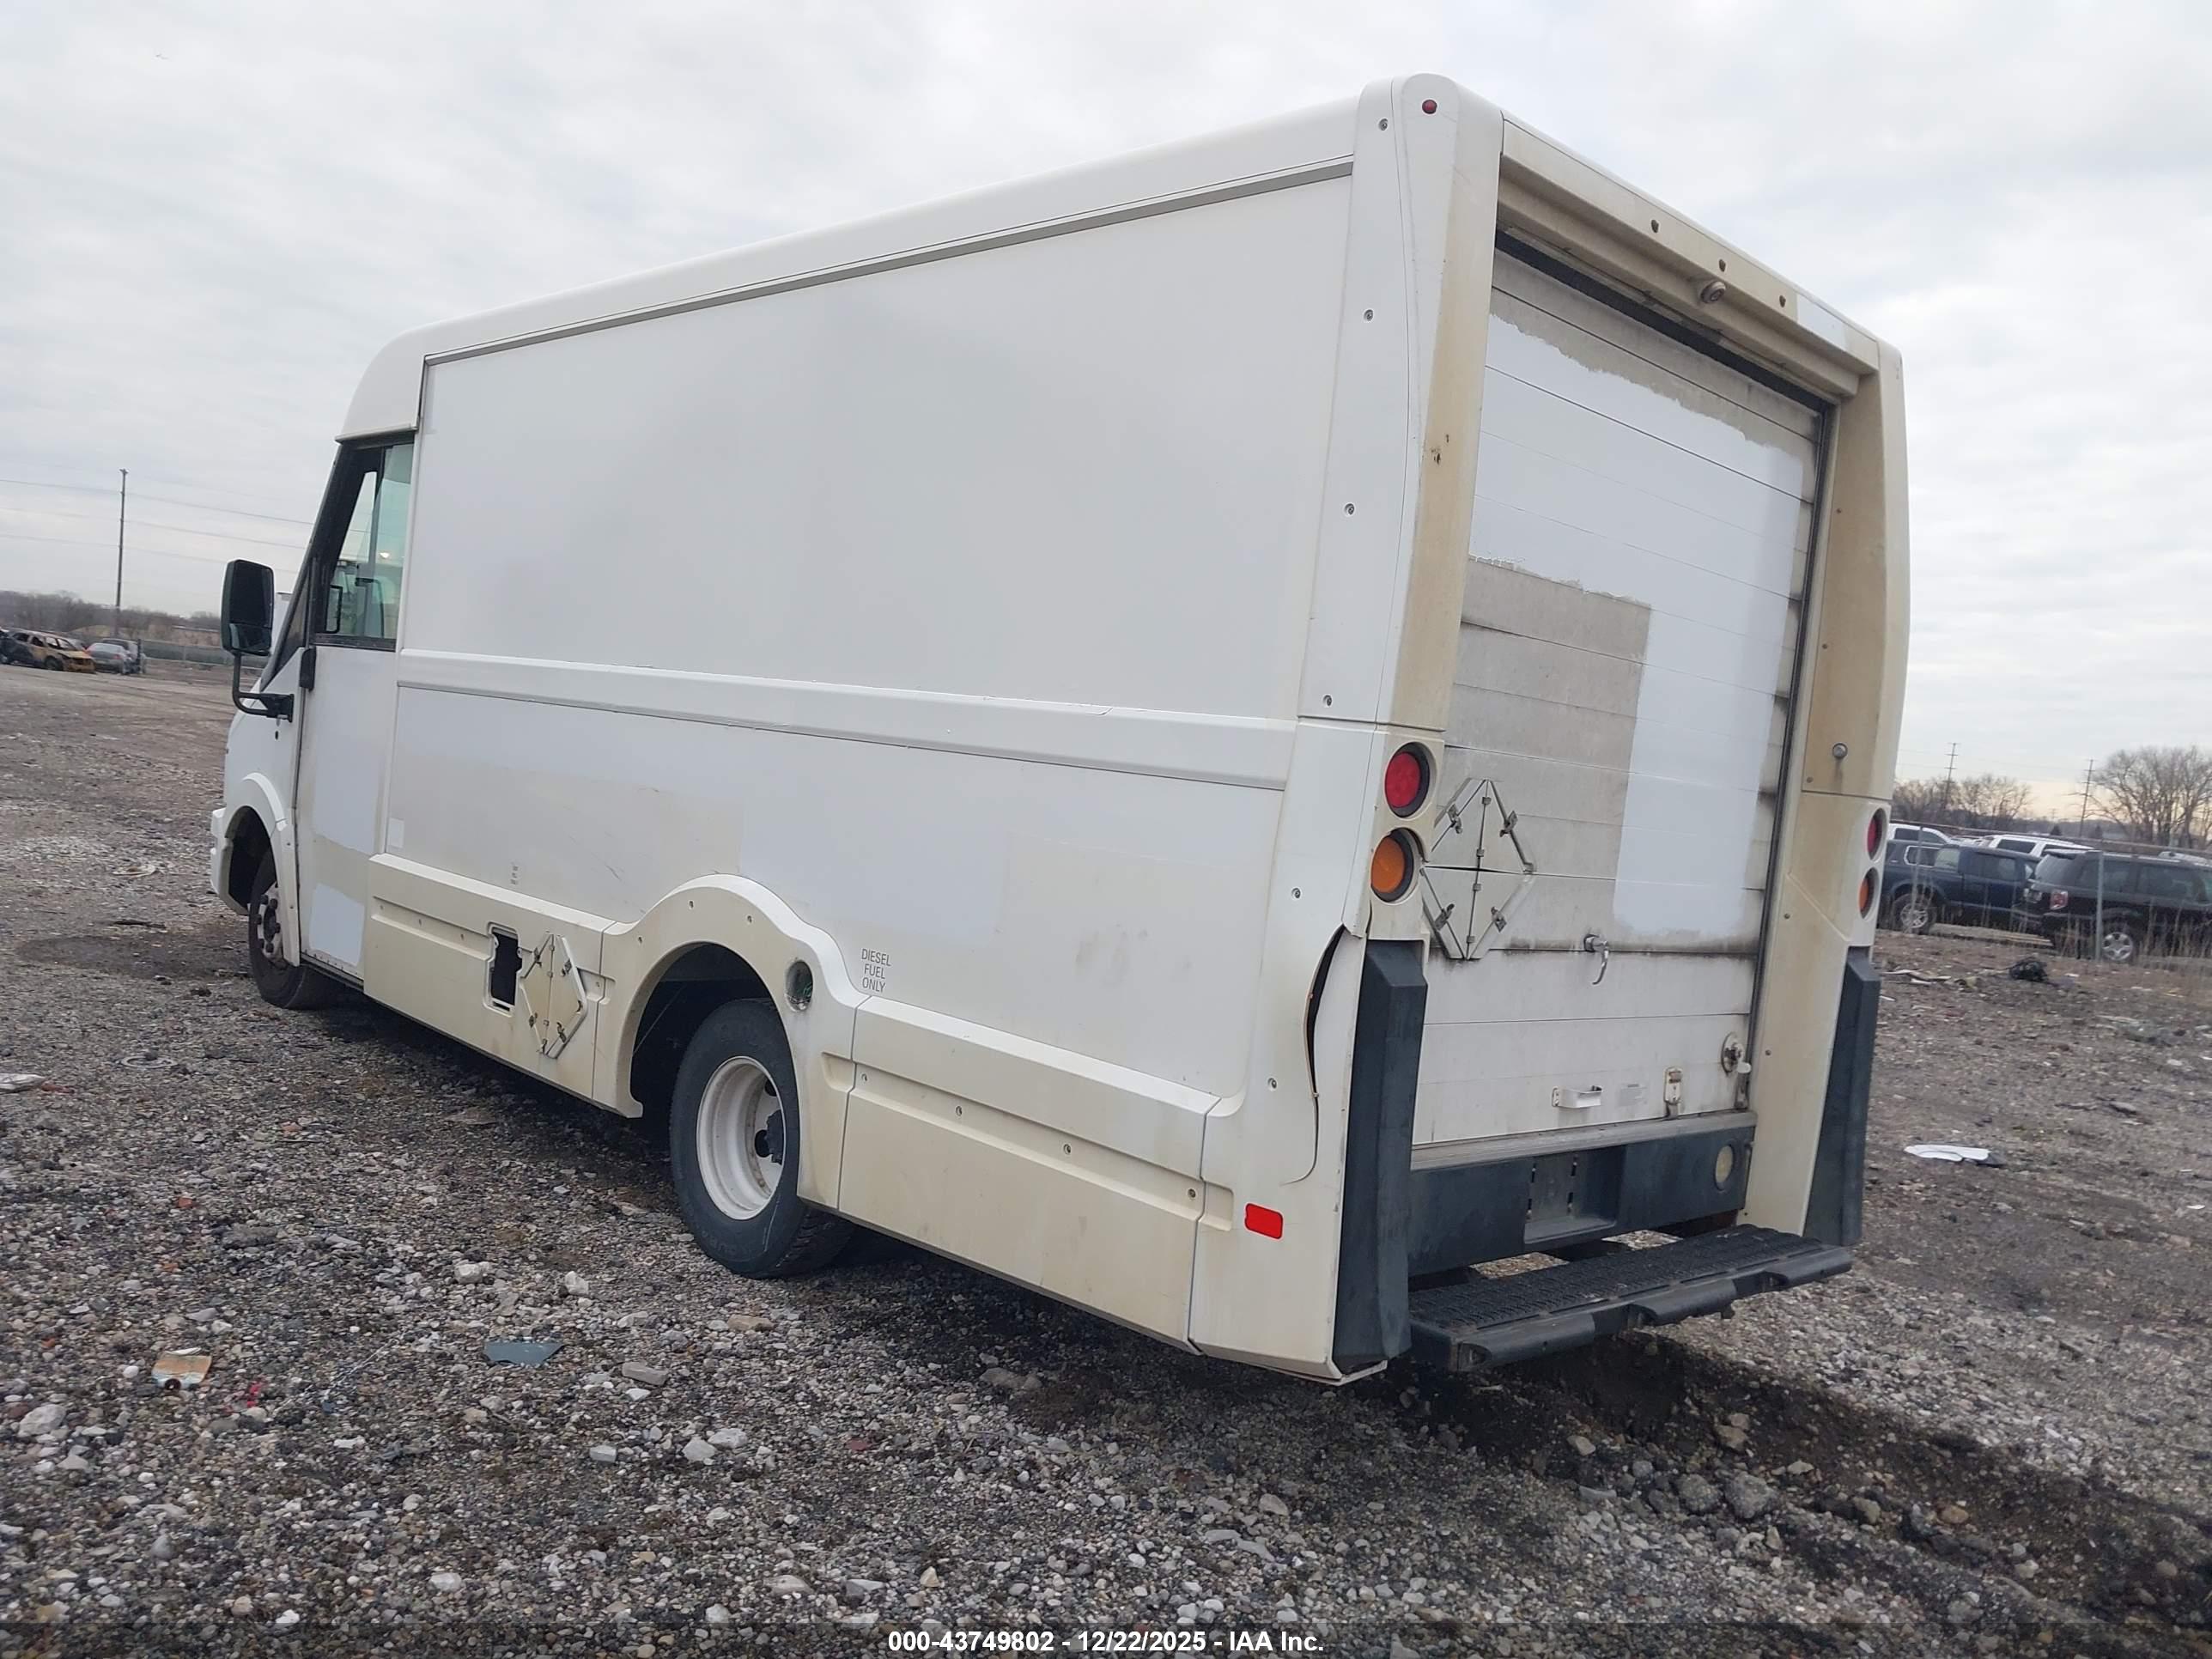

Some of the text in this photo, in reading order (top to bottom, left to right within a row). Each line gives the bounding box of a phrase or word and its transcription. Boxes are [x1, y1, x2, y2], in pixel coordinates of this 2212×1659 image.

[861, 948, 891, 967] DIESEL
[864, 963, 886, 980] FUEL
[862, 976, 886, 994] ONLY
